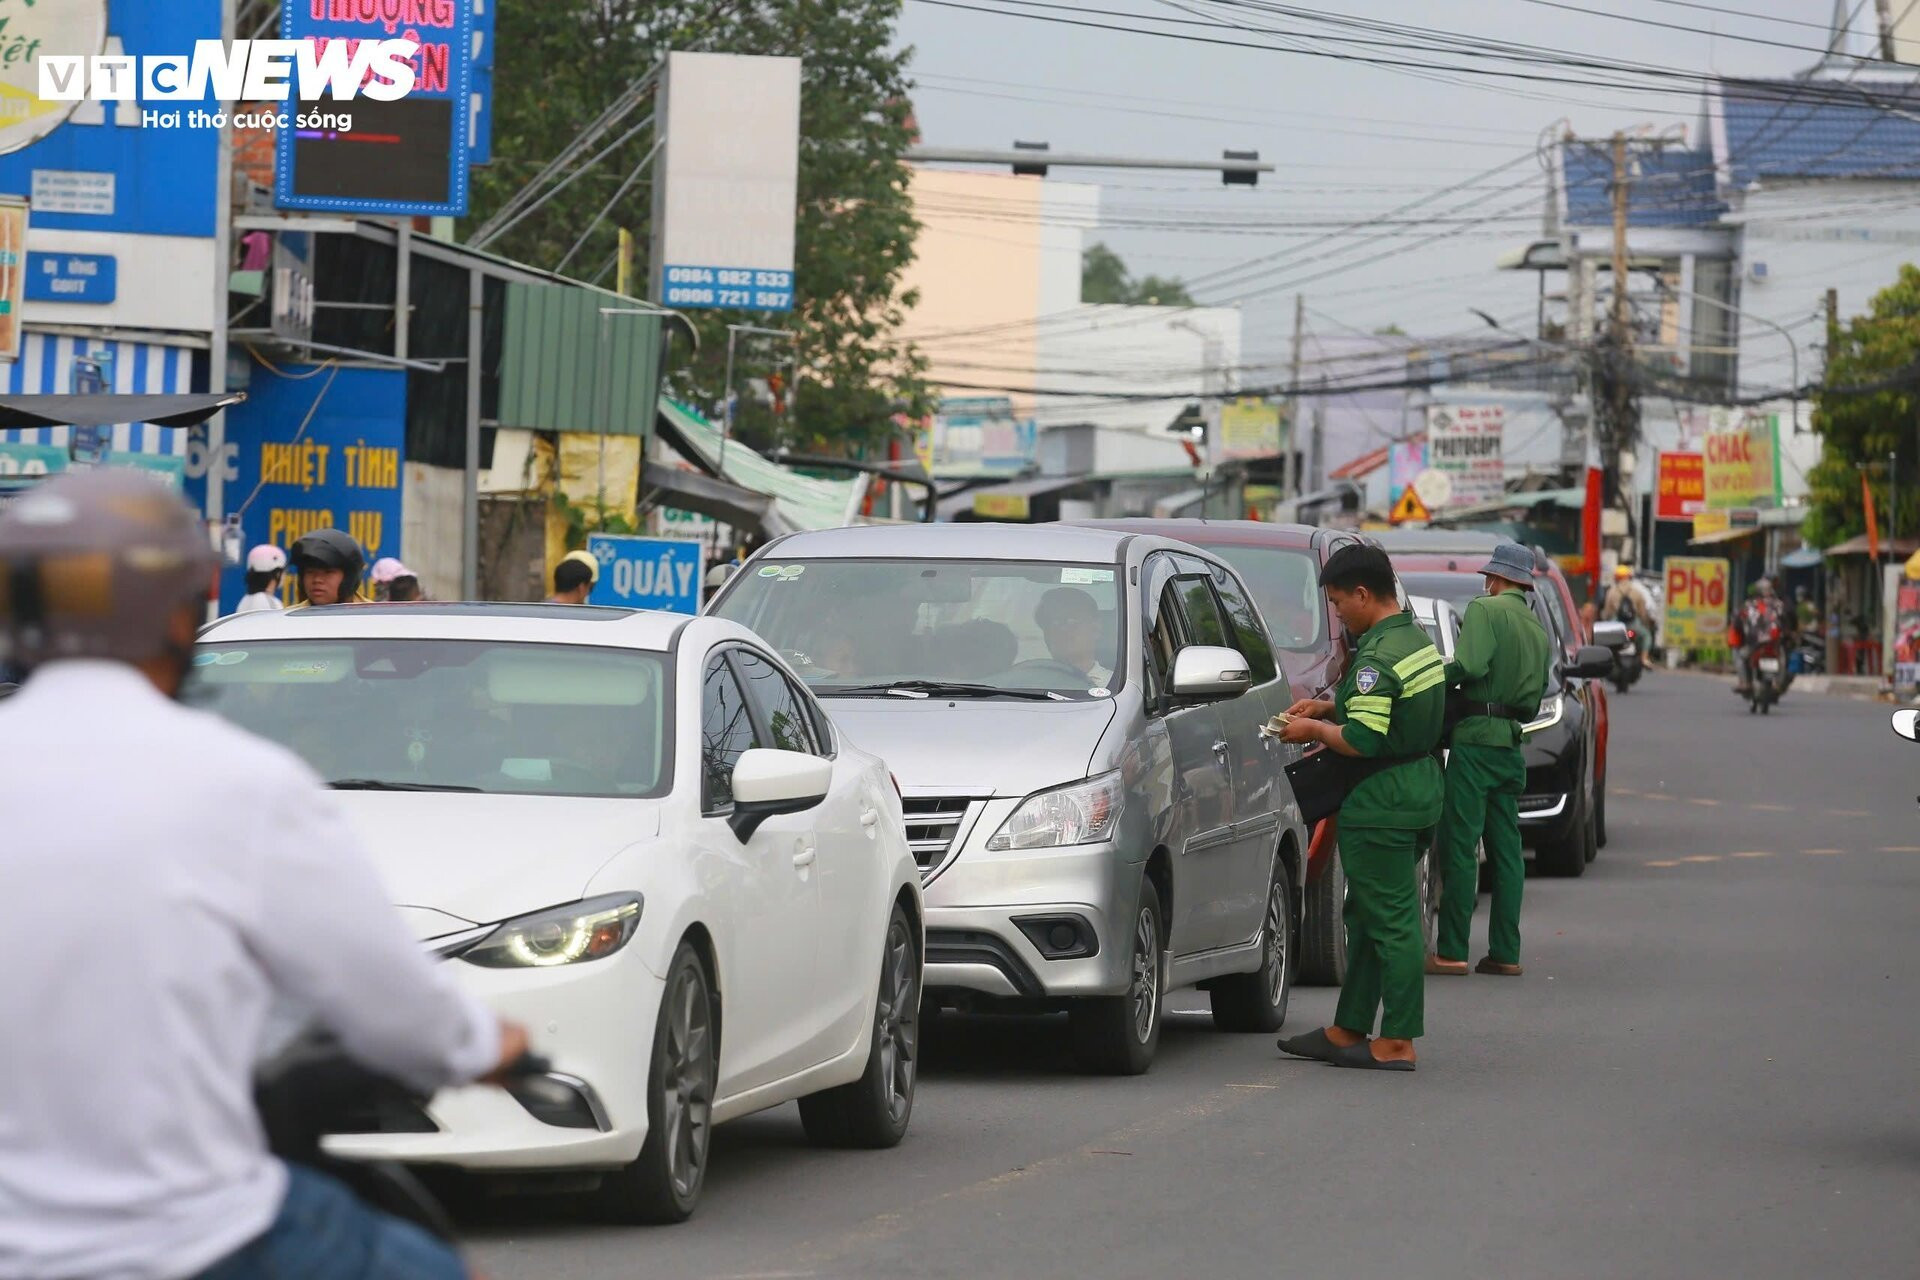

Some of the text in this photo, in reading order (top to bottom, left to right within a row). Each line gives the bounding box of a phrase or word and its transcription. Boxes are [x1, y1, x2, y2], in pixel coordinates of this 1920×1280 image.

[260, 437, 398, 492] NHIỆT TÌNH
[1667, 563, 1725, 607] Phở
